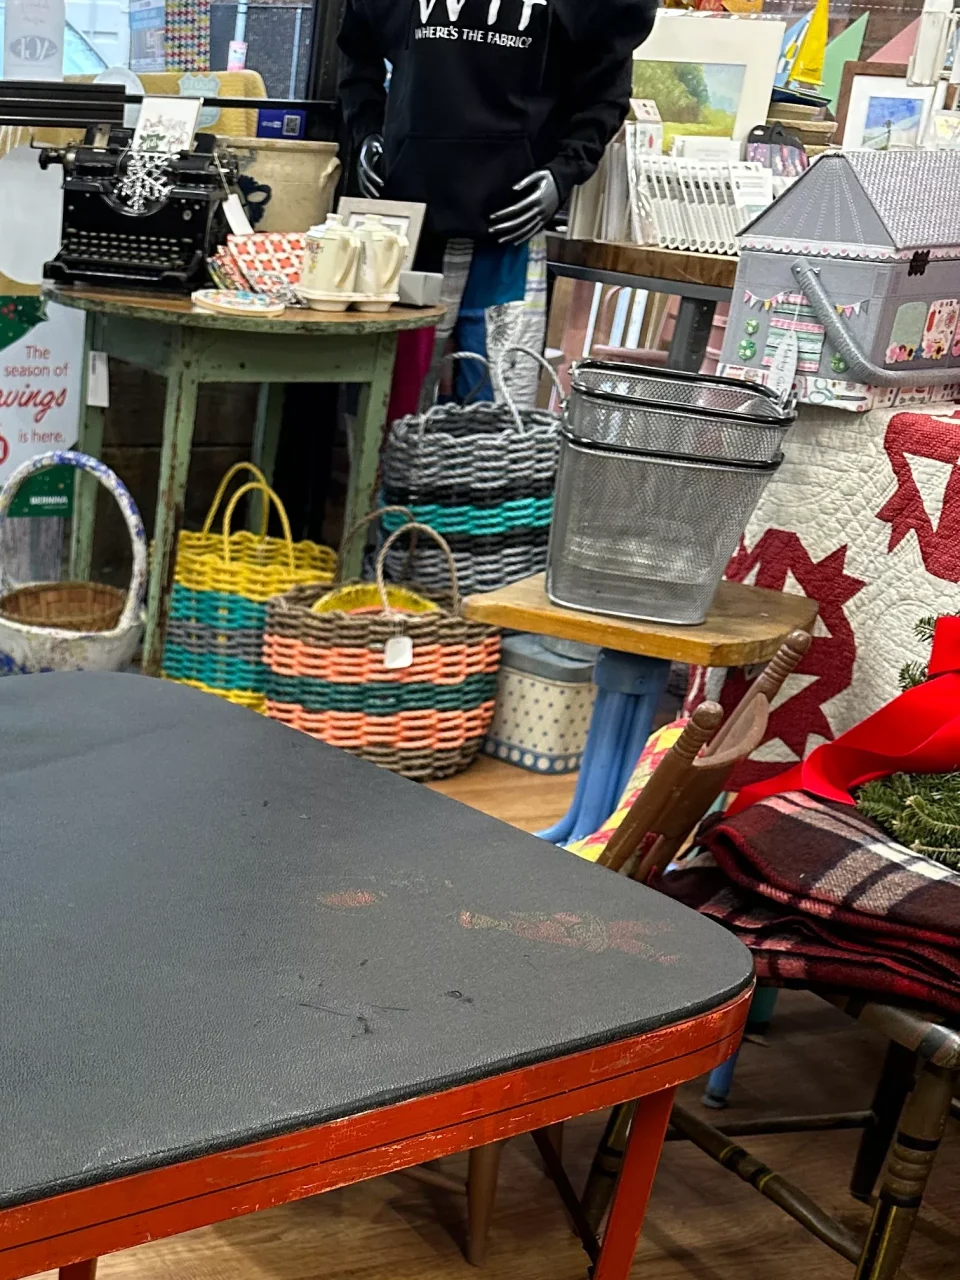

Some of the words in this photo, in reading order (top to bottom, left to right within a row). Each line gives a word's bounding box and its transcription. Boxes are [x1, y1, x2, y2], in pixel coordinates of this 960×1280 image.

[415, 26, 459, 40] WHERE'S
[462, 28, 485, 42] THE
[487, 31, 532, 48] FABRIC?
[25, 345, 51, 360] The
[4, 366, 50, 378] season
[54, 363, 70, 377] of
[18, 429, 29, 444] is
[31, 428, 66, 444] here.
